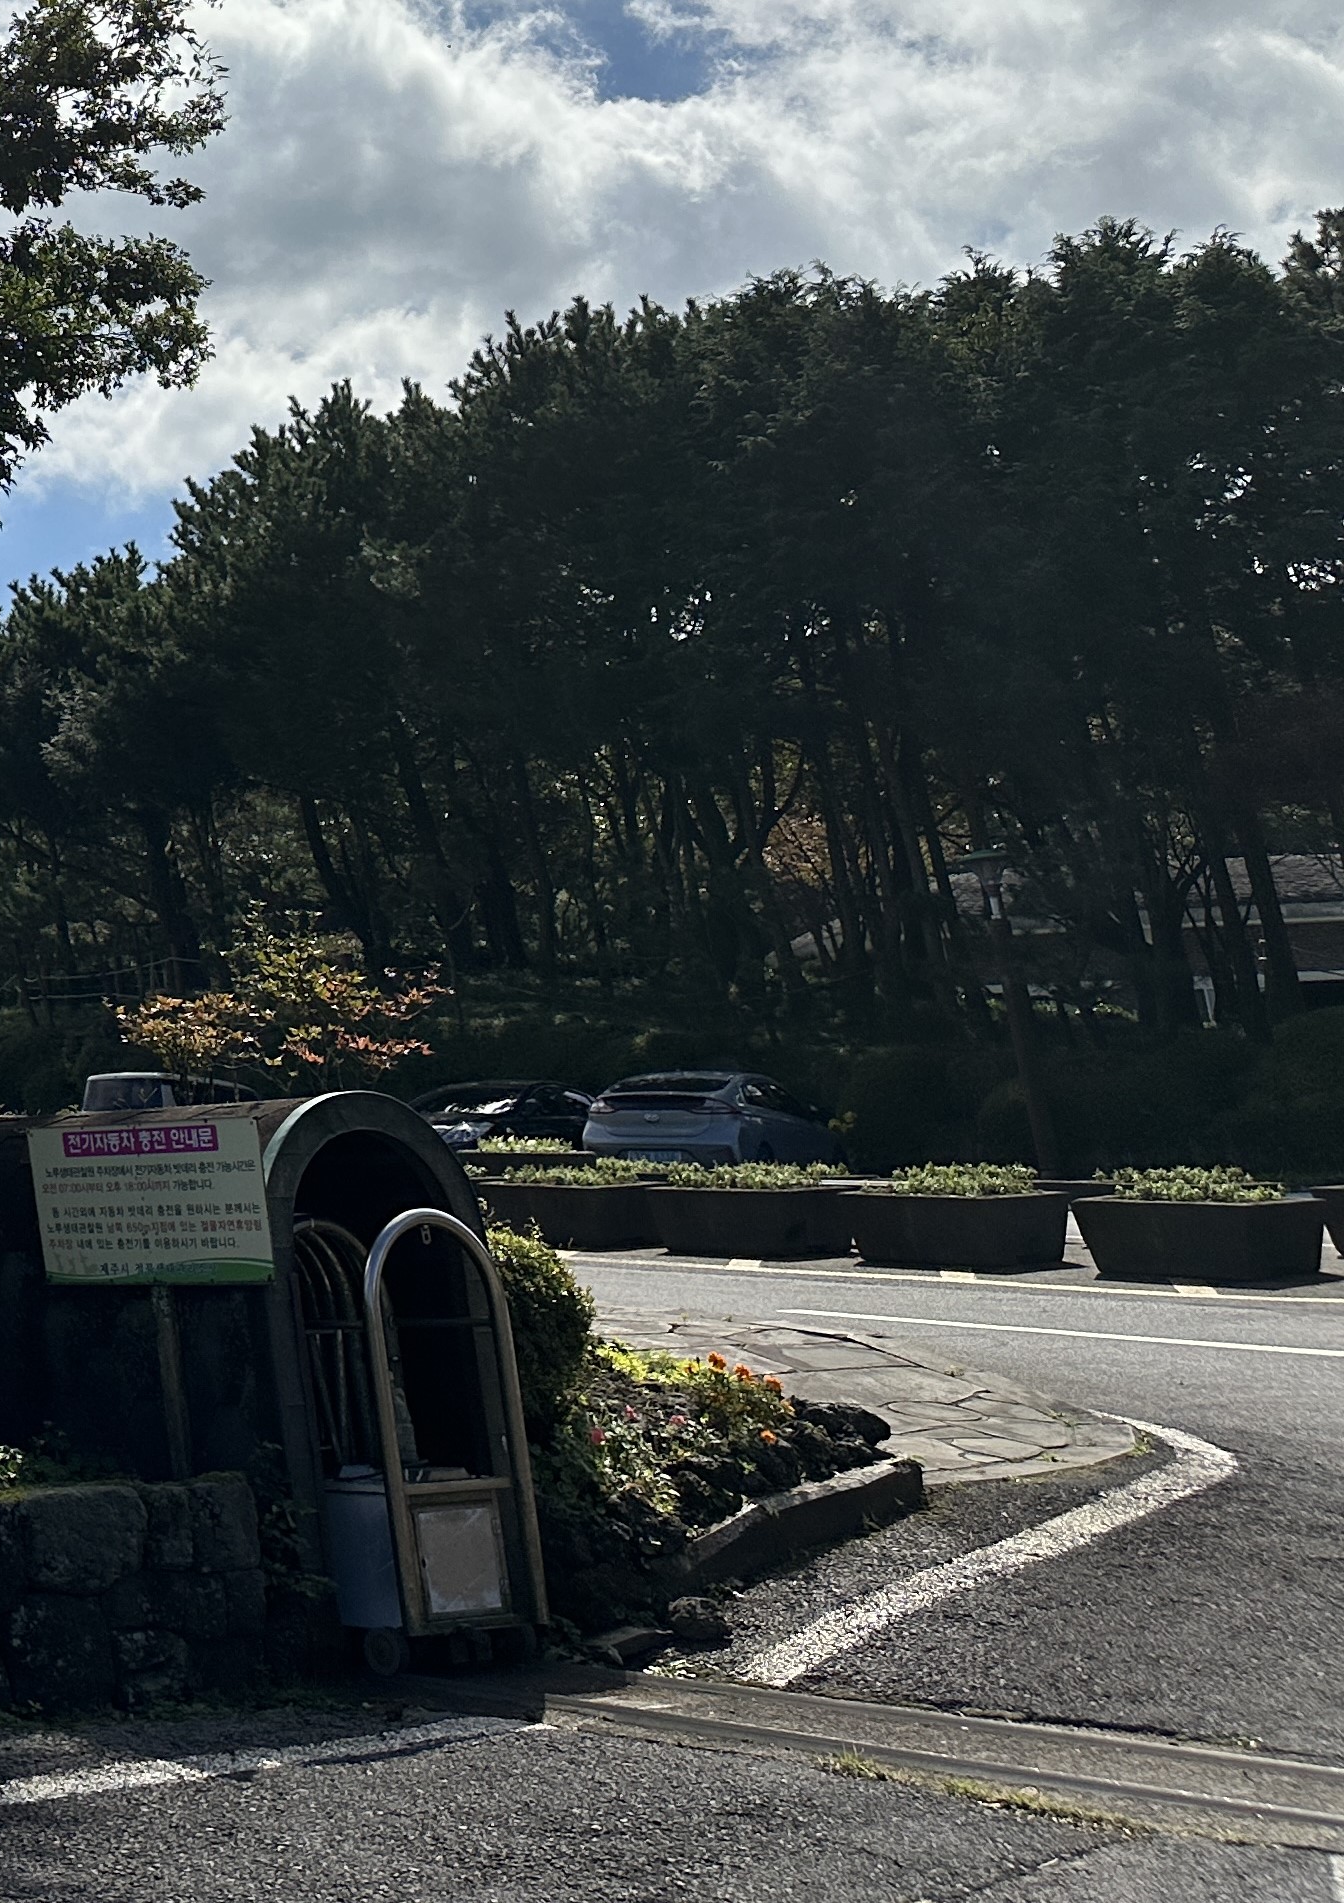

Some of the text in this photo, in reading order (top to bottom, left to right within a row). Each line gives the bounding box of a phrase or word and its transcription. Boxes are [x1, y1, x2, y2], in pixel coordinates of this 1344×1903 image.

[68, 1128, 214, 1153] 전기자동차 충전 안내문
